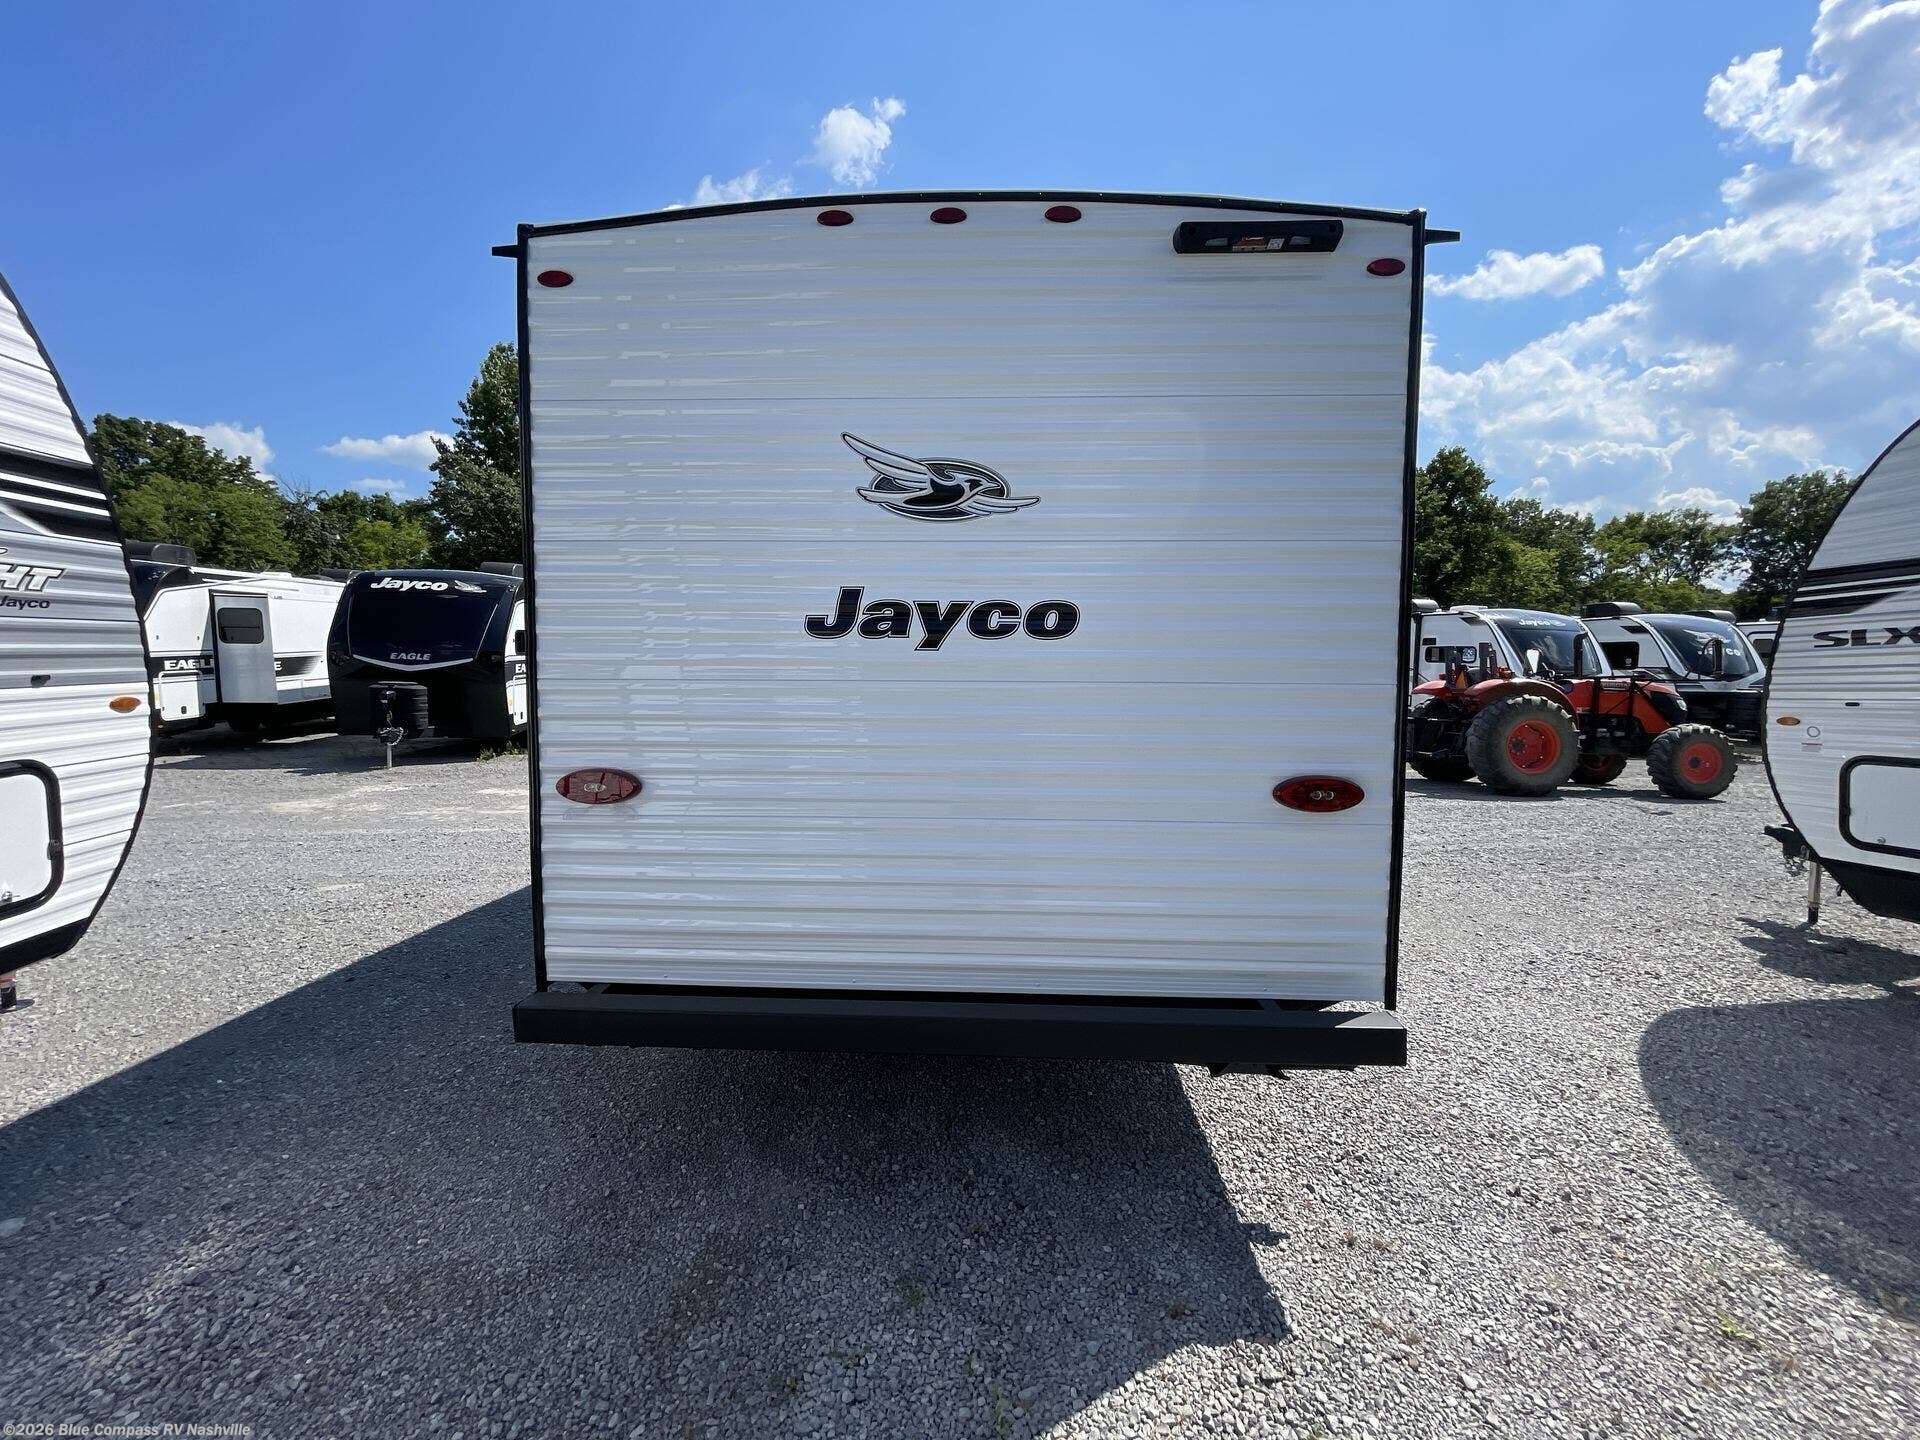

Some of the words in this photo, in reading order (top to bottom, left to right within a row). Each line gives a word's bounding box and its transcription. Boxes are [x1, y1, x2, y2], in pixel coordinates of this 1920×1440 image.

[371, 577, 448, 591] Jayco
[0, 595, 51, 611] Jayco
[804, 586, 1081, 651] Jayco
[1813, 626, 1920, 648] SLX
[390, 652, 431, 661] EAGLE
